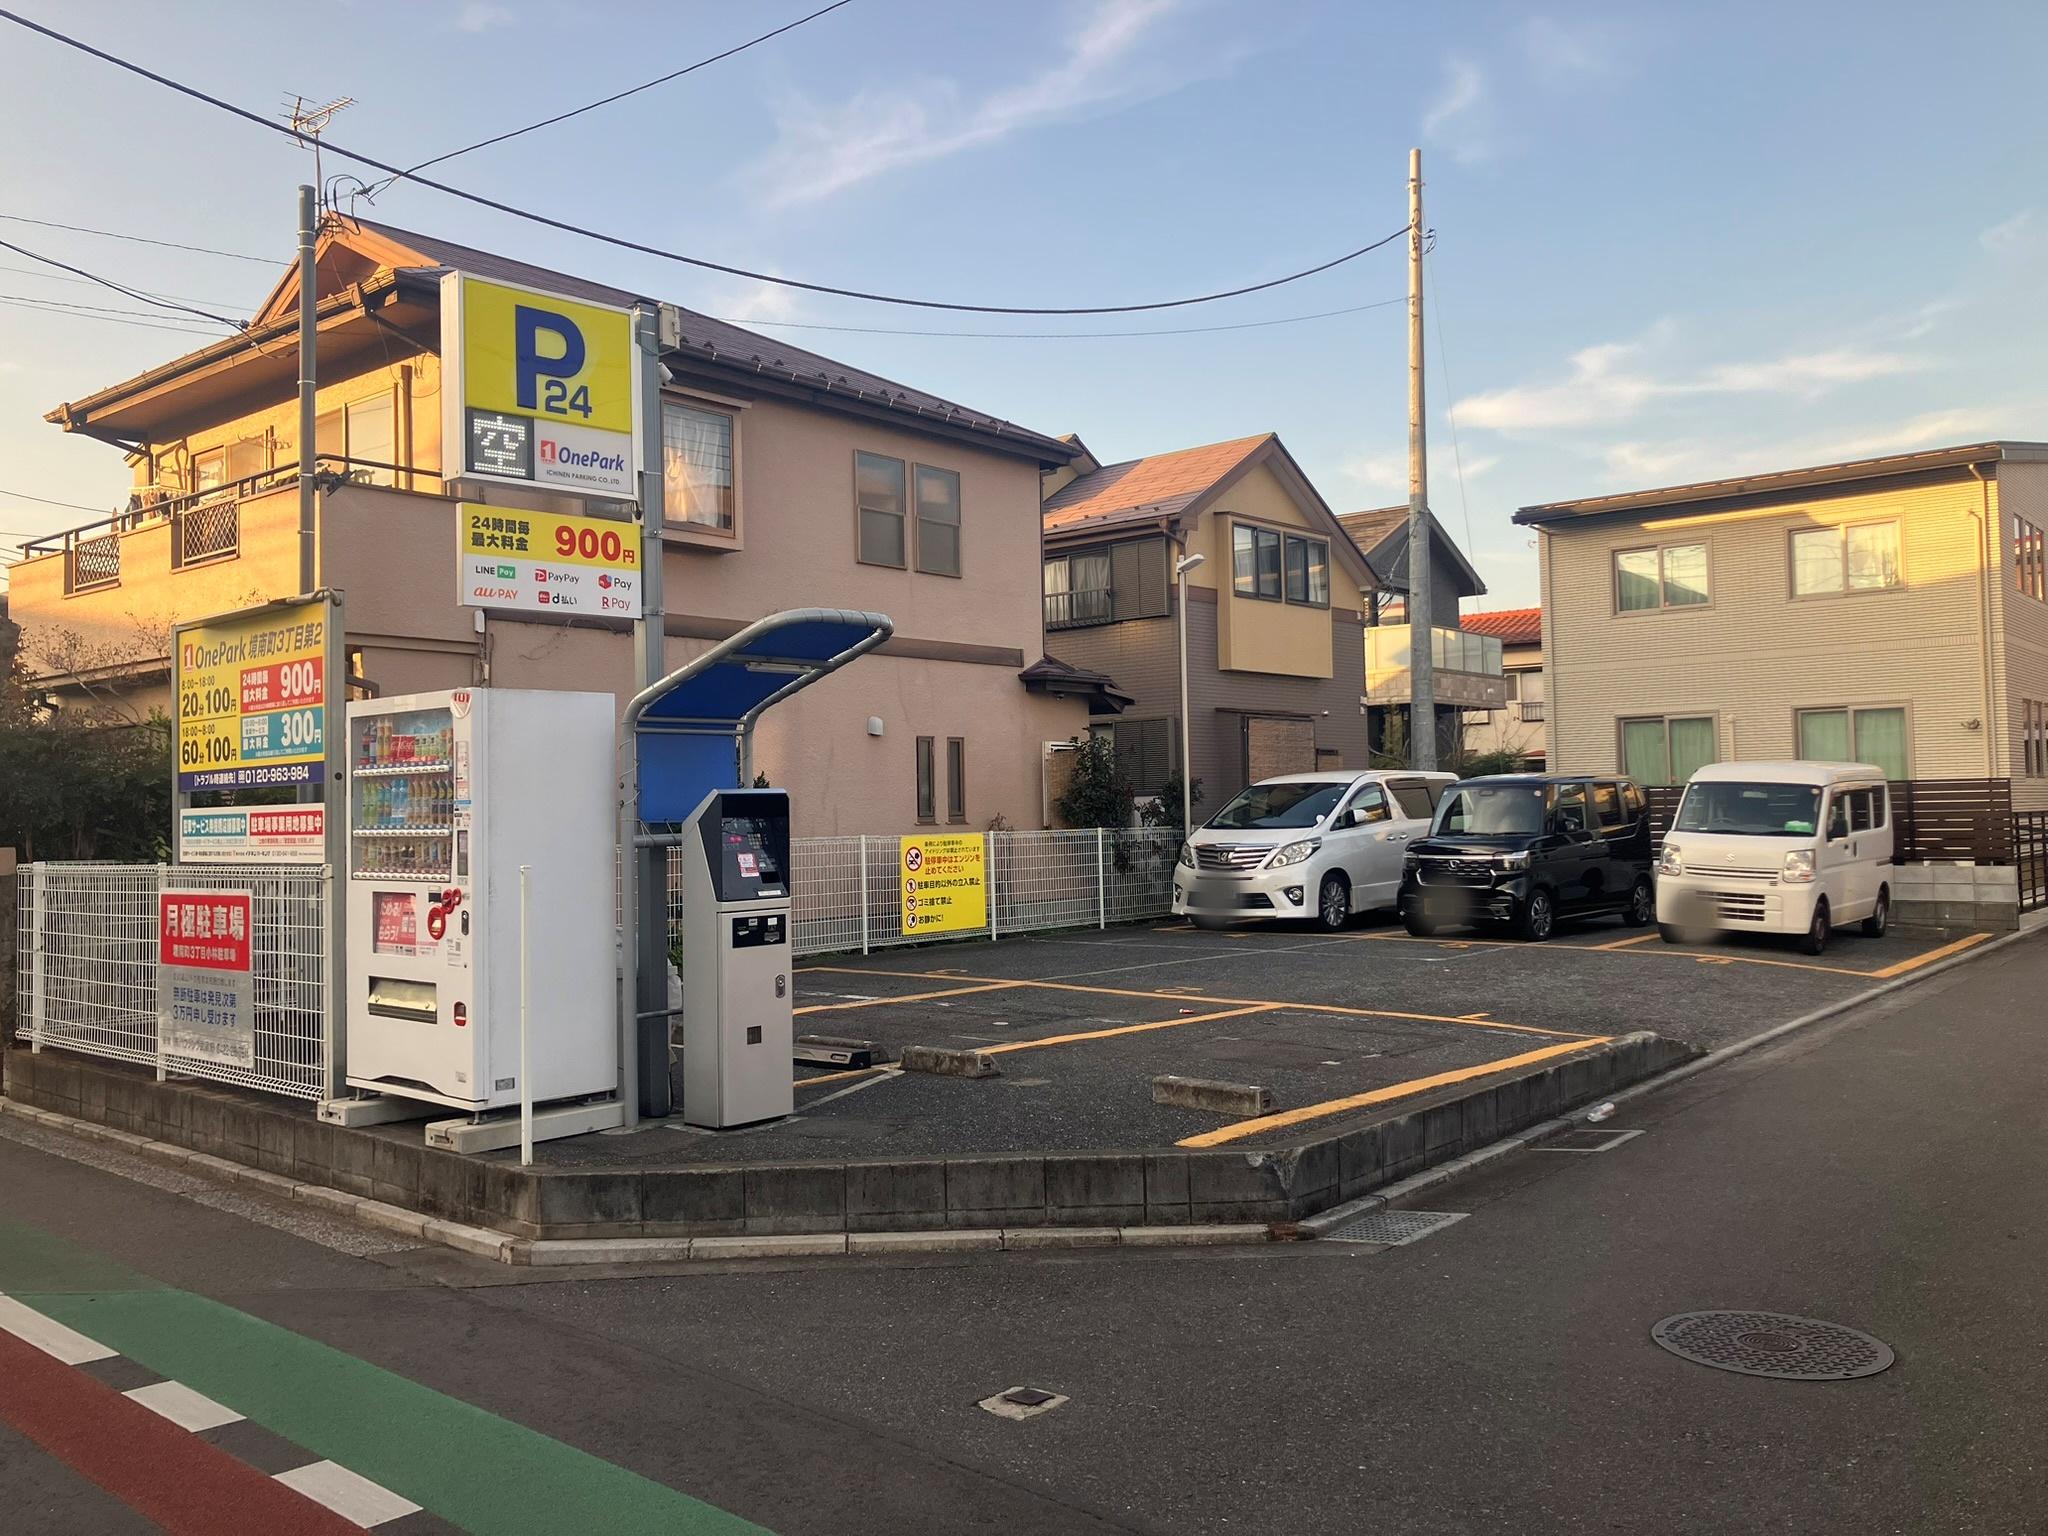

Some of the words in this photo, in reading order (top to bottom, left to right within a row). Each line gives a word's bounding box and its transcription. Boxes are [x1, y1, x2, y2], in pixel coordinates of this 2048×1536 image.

[515, 304, 586, 410] P
[544, 379, 593, 419] 24
[473, 415, 526, 476] 空
[558, 446, 625, 472] OnePark
[571, 472, 597, 482] PARKING
[471, 515, 530, 536] 24時間毎
[471, 531, 529, 551] 最大料金
[554, 525, 635, 564] 900円
[475, 564, 495, 576] LINE
[498, 567, 514, 577] Pay
[548, 571, 580, 584] PayPay
[473, 586, 497, 597] au
[497, 588, 518, 599] PAY
[614, 577, 632, 591] Pay
[601, 596, 610, 609] R
[611, 597, 631, 611] Pay
[195, 639, 247, 670] OnePark
[280, 661, 322, 698] 900円
[280, 710, 322, 747] 300円
[245, 766, 309, 784] 0120-963-984
[917, 876, 980, 890] 駐車目的以外の立入禁止
[918, 896, 952, 907] ゴミ捨て禁止
[165, 904, 244, 941] 月極駐車場
[173, 986, 237, 1009] 無断駐車は発見次第
[172, 1005, 236, 1028] 3万円申し受けます
